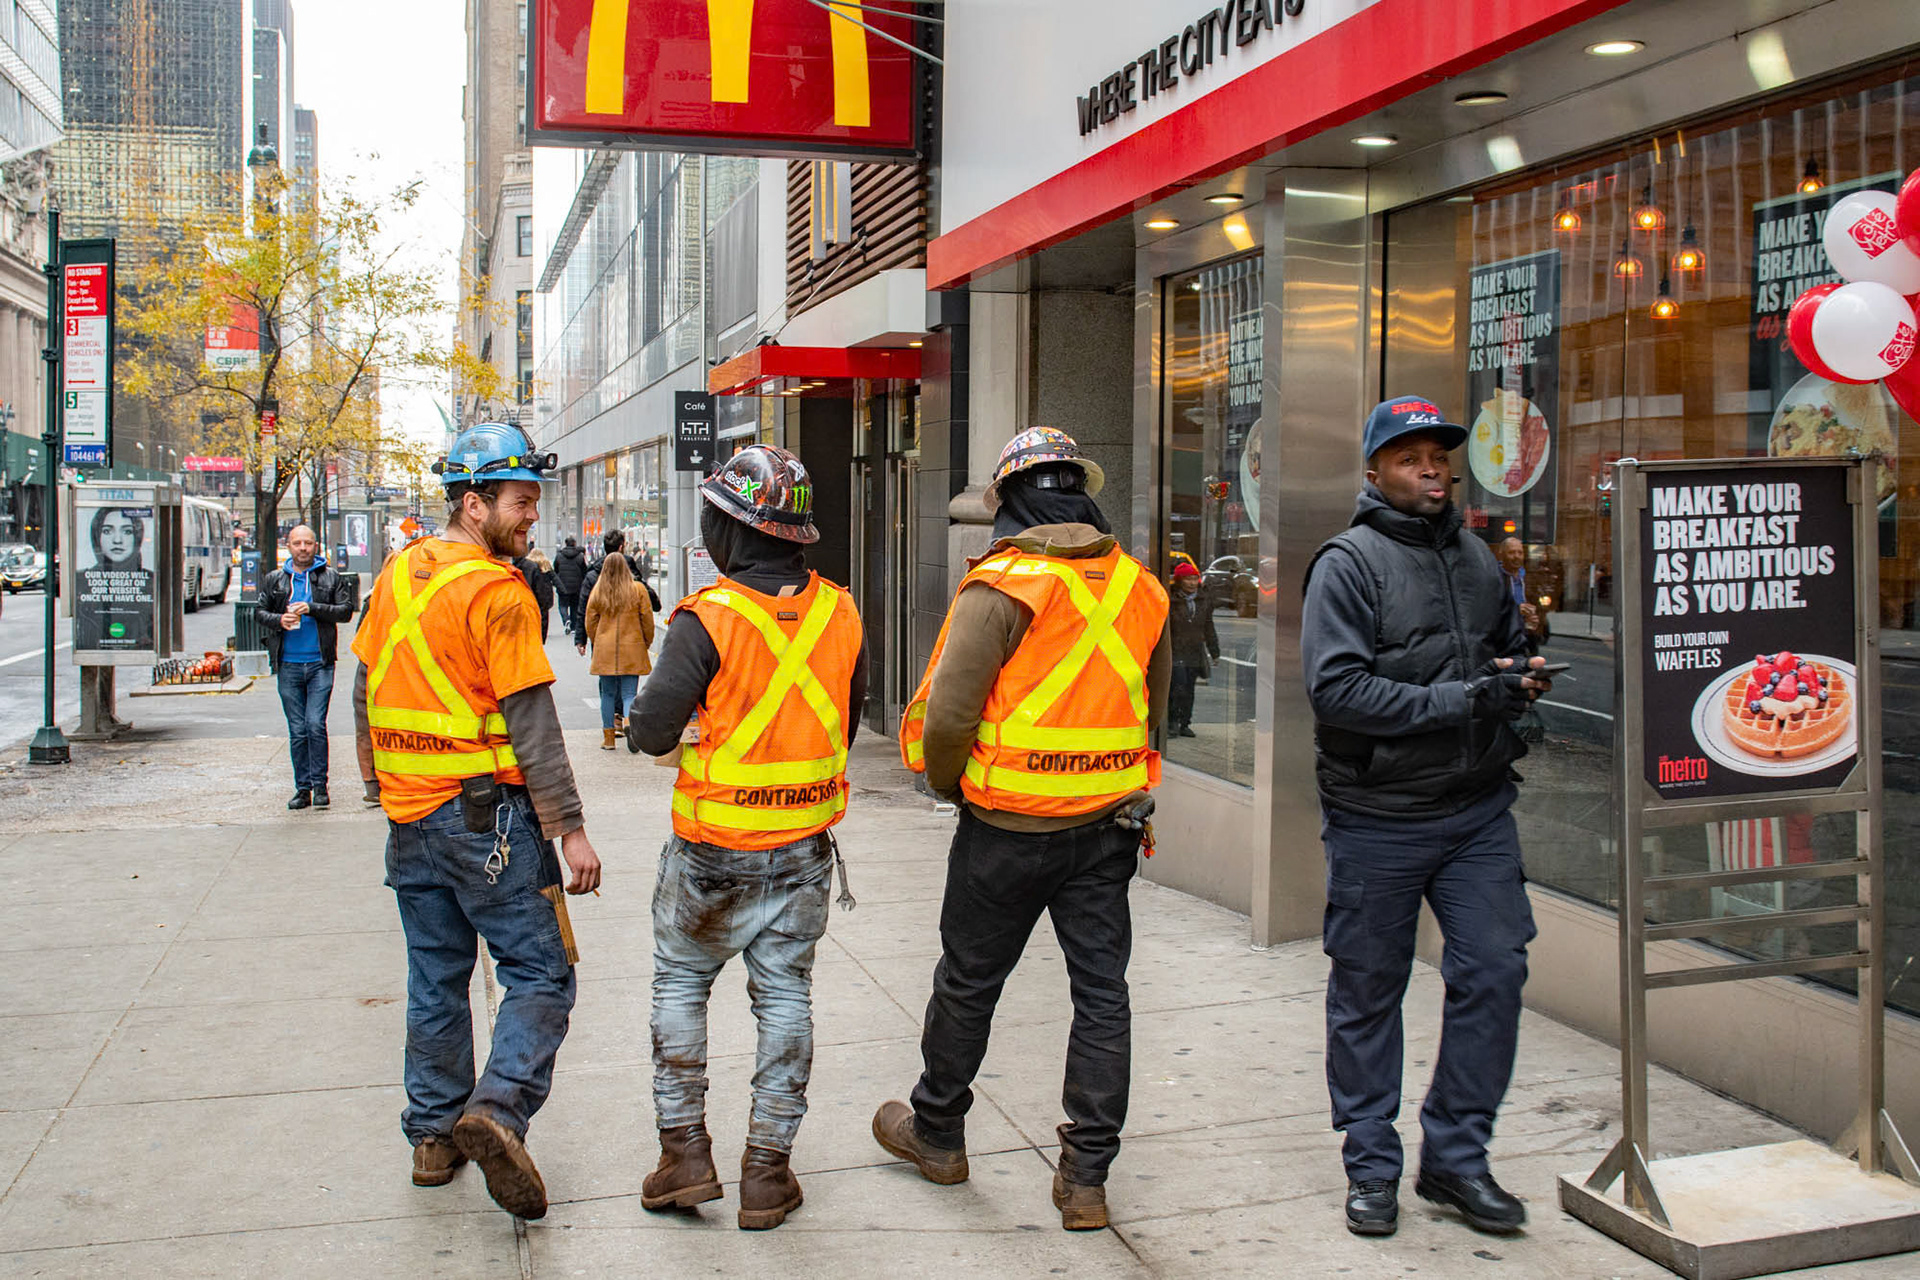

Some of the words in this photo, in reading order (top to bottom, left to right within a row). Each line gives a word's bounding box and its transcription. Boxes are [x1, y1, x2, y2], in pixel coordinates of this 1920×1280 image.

[1076, 61, 1137, 136] WHERE
[1138, 35, 1179, 101] THE
[1179, 0, 1235, 76] CITY
[1759, 214, 1810, 250] MAKE
[1472, 271, 1504, 299] MAKE
[1506, 264, 1537, 291] YOUR
[1471, 289, 1536, 323] BREAKFAST
[1757, 282, 1780, 313] AS
[68, 319, 77, 335] 3
[1469, 323, 1485, 348] AS
[1487, 312, 1552, 345] AMBITIOUS
[1469, 348, 1485, 372] AS
[1486, 343, 1510, 370] YOU
[1511, 341, 1538, 366] ARE.
[67, 393, 76, 408] 5
[1246, 382, 1262, 404] BAC
[684, 402, 706, 411] Café
[97, 489, 134, 500] TITAN
[1652, 485, 1728, 517] MAKE
[1731, 482, 1802, 514] YOUR
[1653, 515, 1800, 550] BREAKFAST
[84, 571, 101, 579] OUR
[102, 571, 130, 579] VIDEOS
[131, 571, 150, 579] WILL
[1653, 552, 1689, 583] AS
[1692, 545, 1836, 581] AMBITIOUS
[88, 579, 109, 587] LOOK
[109, 579, 133, 587] GREAT
[134, 579, 146, 587] ON
[91, 587, 108, 595] OUR
[81, 594, 100, 602] ONCE
[101, 594, 114, 602] WE
[115, 594, 135, 602] HAVE
[1654, 585, 1690, 616] AS
[1692, 582, 1746, 614] YOU
[1750, 579, 1807, 611] ARE.
[1654, 633, 1681, 649] BUILD
[1682, 631, 1707, 647] YOUR
[1707, 630, 1730, 645] OWN
[1655, 648, 1722, 671] WAFFLES
[1659, 756, 1708, 783] metro
[734, 780, 838, 806] CONTRACTOR
